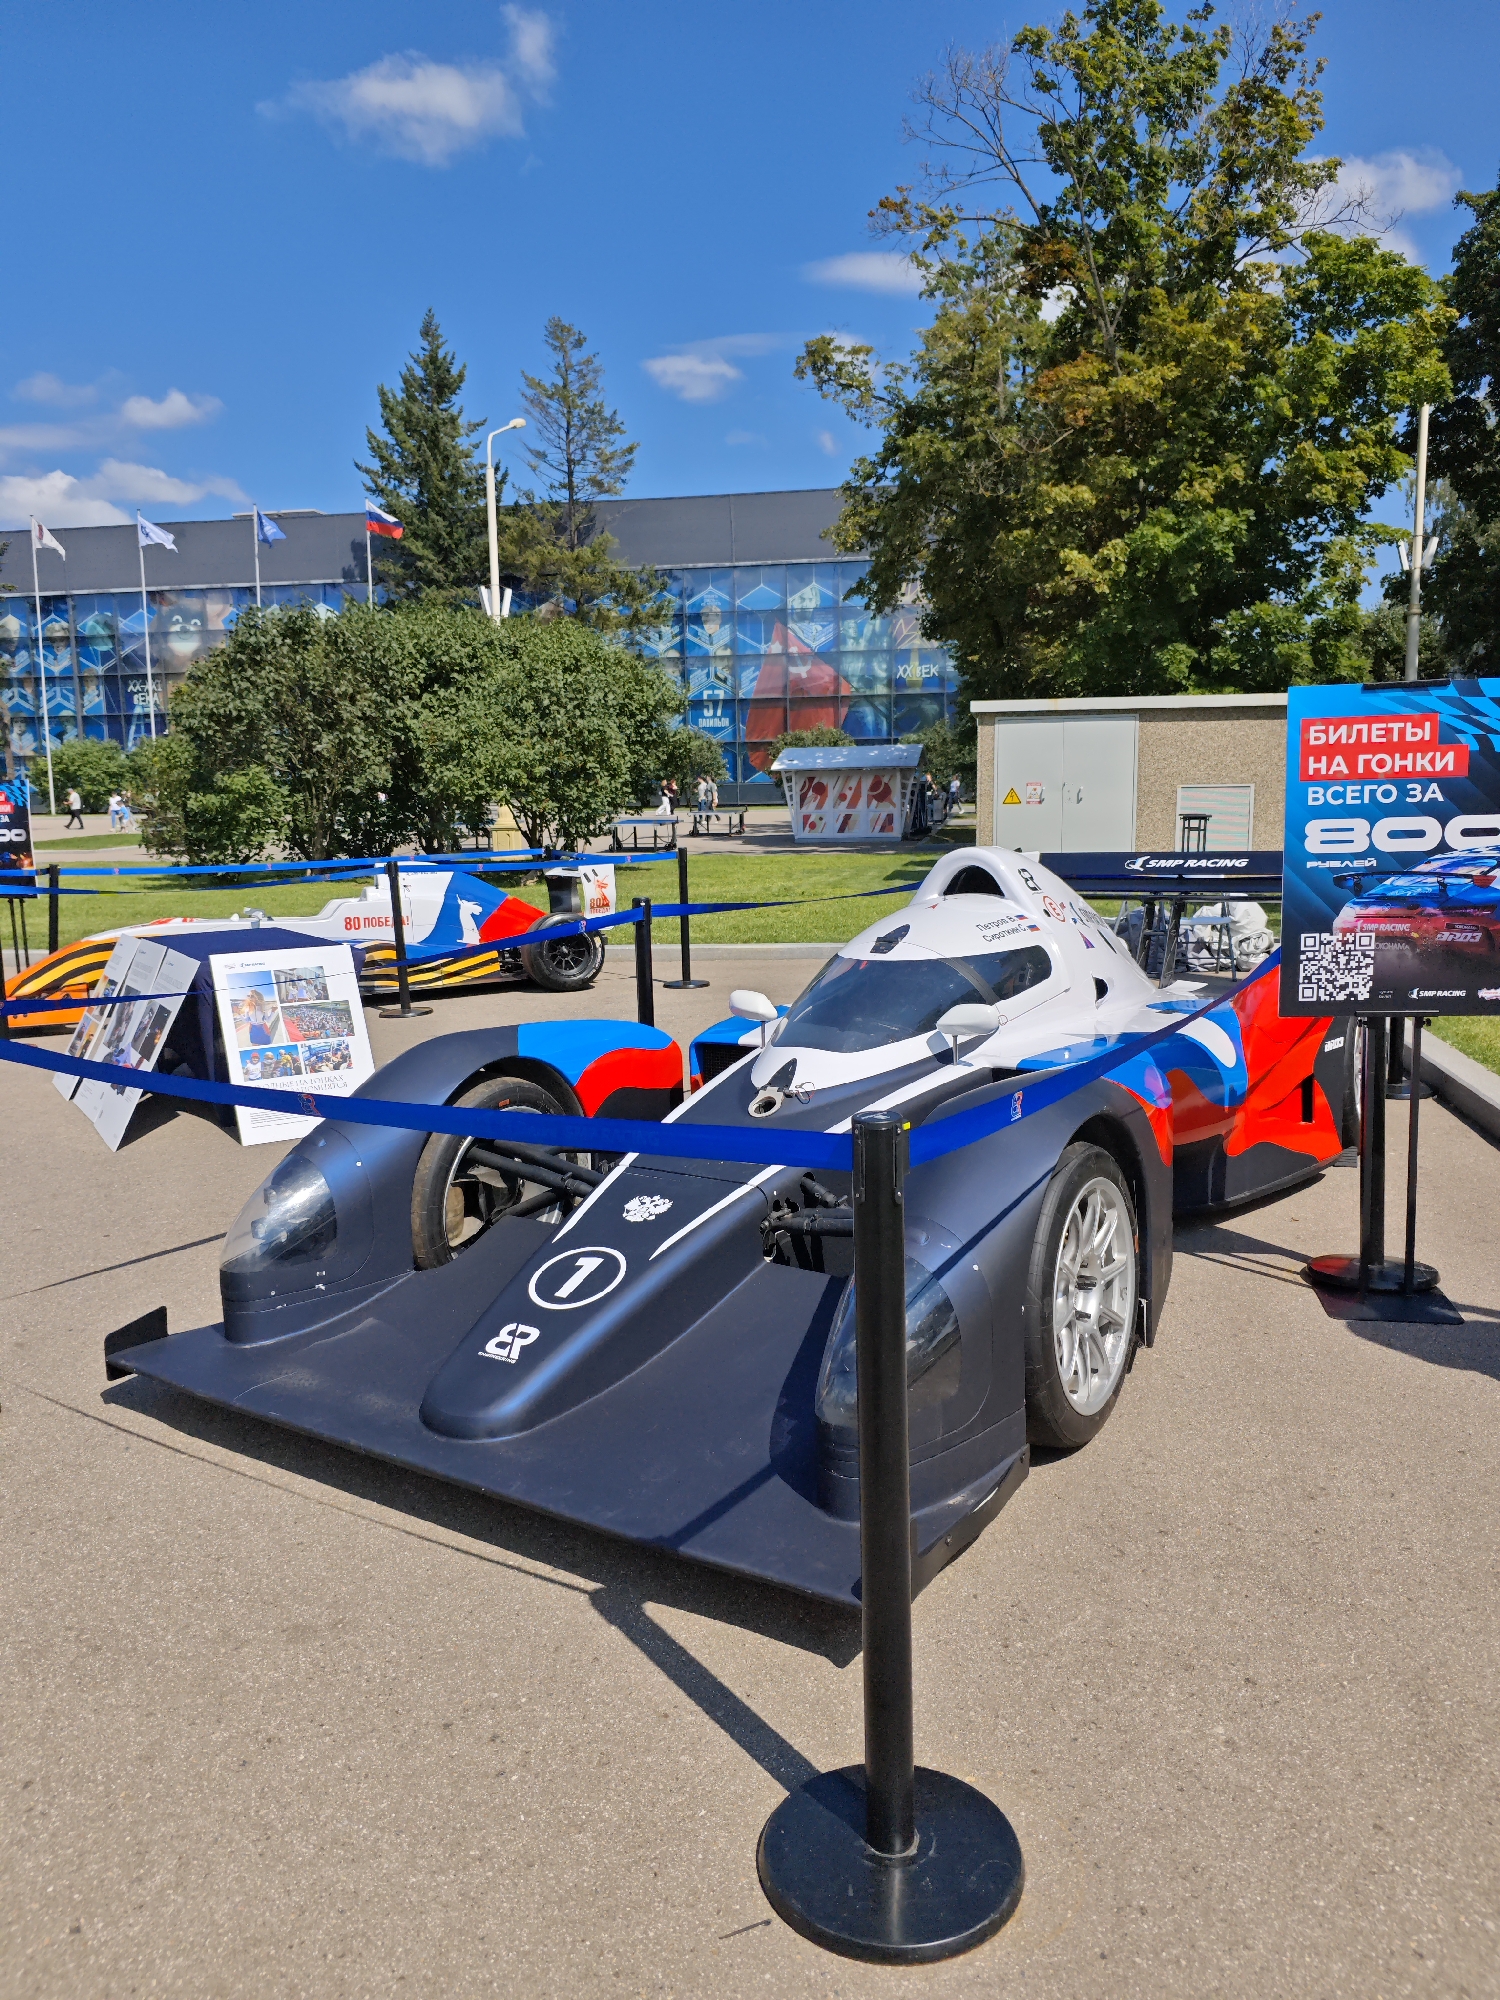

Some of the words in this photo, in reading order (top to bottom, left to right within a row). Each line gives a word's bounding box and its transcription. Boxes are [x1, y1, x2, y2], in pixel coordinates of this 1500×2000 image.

[916, 664, 939, 678] ВЕК
[702, 690, 725, 717] 57
[1308, 721, 1431, 746] БИЛЕТЫ
[1308, 754, 1349, 776] НА
[1357, 751, 1455, 774] ГОНКИ
[1307, 784, 1398, 806] ВСЕГО
[1405, 782, 1445, 803] ЗА
[1145, 859, 1184, 868] SMP
[1184, 858, 1250, 868] RACING
[1306, 857, 1377, 869] РУБЛЕЙ
[344, 916, 361, 931] 80
[976, 919, 1009, 932] Петров
[1362, 923, 1379, 931] SMP
[982, 926, 1019, 942] Сироткин
[1374, 942, 1410, 950] OKOHAMA
[554, 1255, 605, 1299] 1
